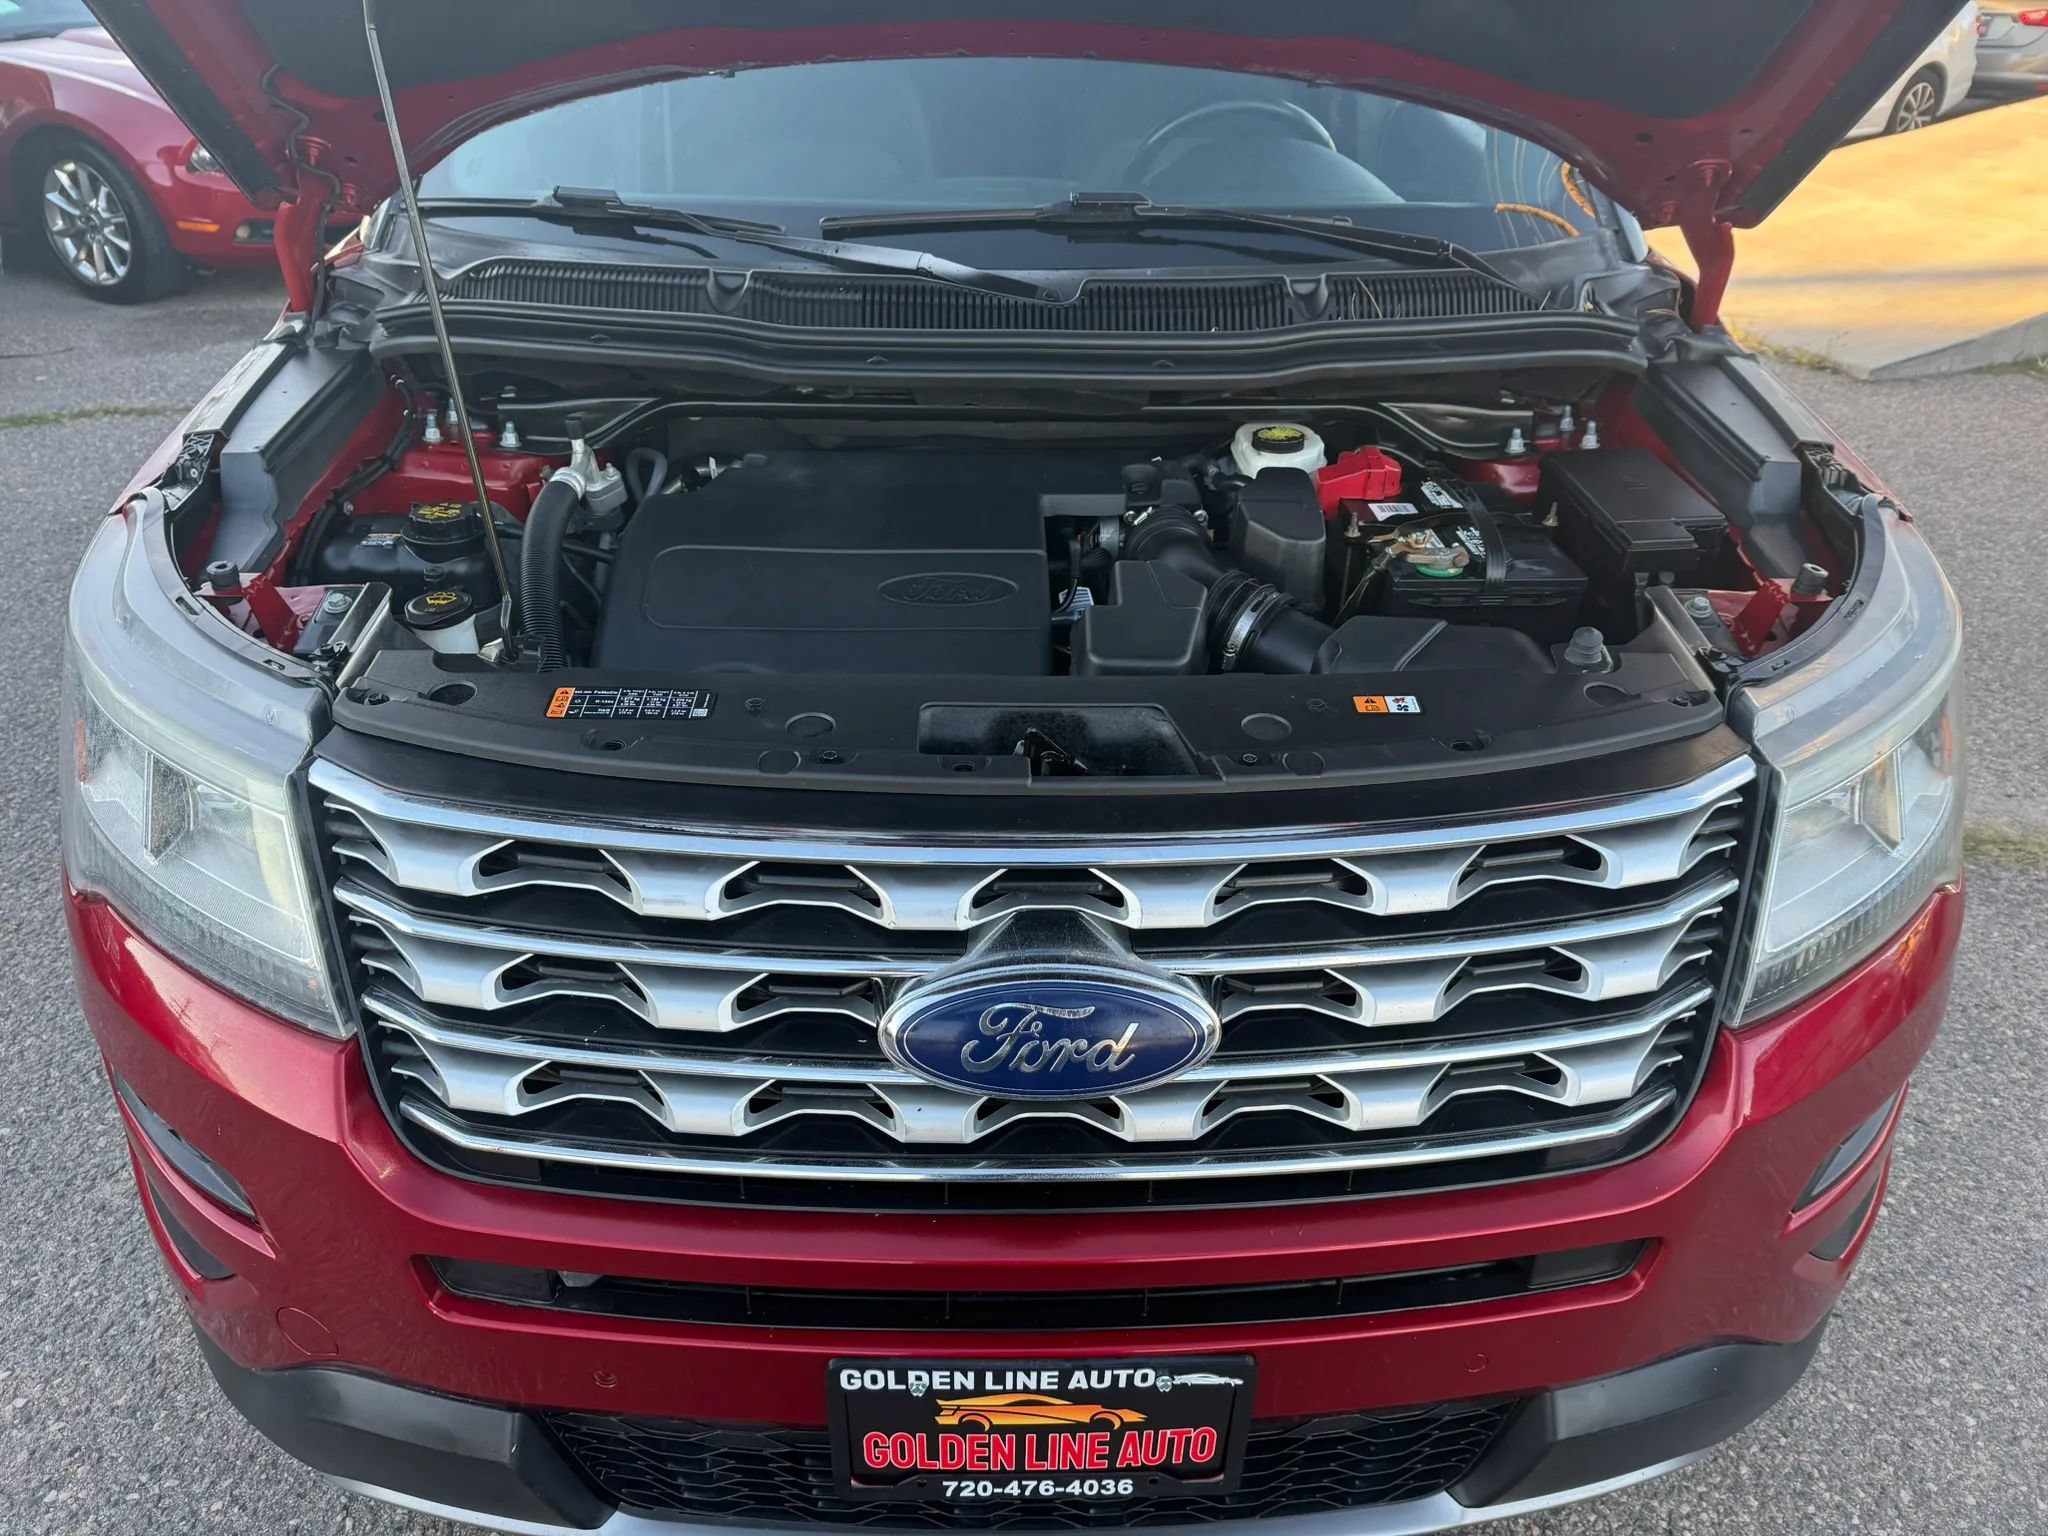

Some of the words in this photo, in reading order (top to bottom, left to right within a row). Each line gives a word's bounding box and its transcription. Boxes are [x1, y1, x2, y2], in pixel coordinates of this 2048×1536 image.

[960, 1002, 1139, 1073] Ford
[839, 1368, 975, 1391] GOLDEN
[985, 1369, 1059, 1390] LINE
[1067, 1368, 1155, 1390] AUTO
[862, 1431, 1016, 1471] GOLDEN
[1025, 1431, 1109, 1471] LINE
[1117, 1426, 1218, 1467] AUTO
[942, 1479, 1134, 1497] 720-476-4036
